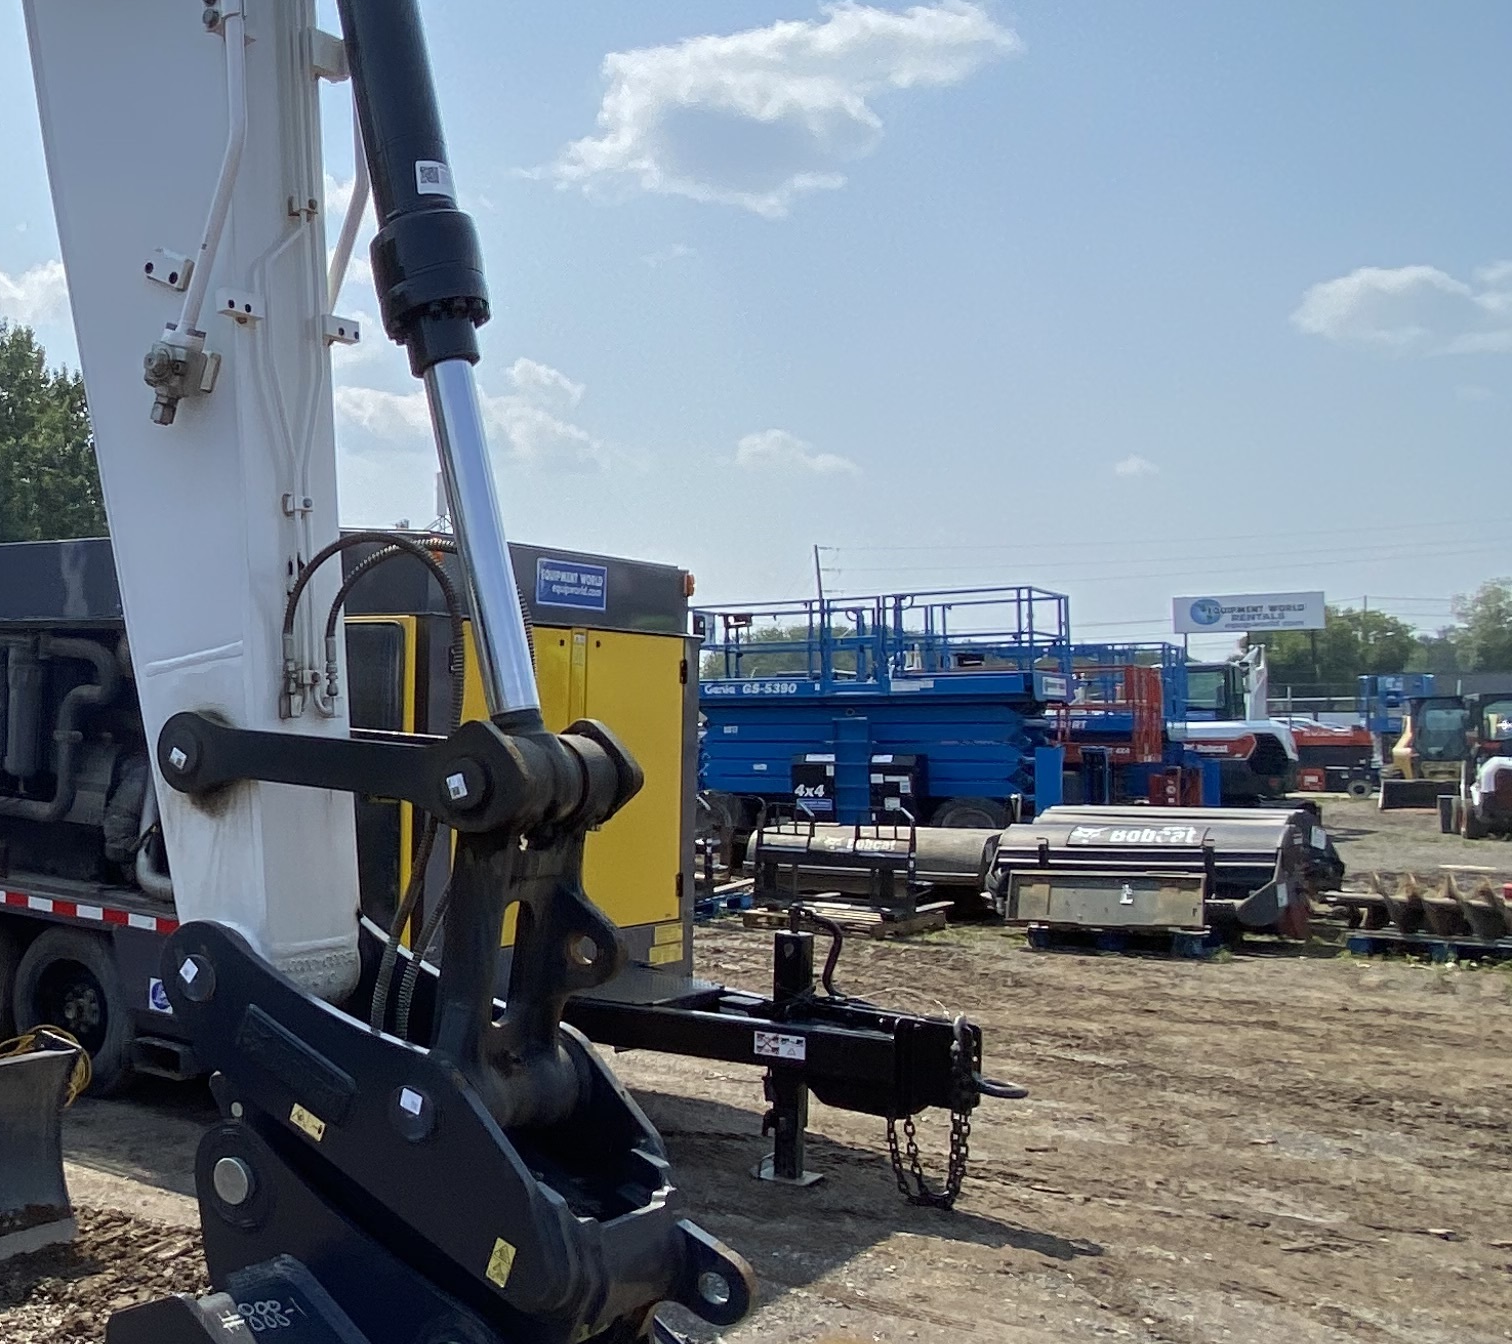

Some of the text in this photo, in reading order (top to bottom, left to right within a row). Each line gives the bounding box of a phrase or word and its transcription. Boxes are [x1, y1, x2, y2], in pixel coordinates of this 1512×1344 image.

[1268, 603, 1305, 612] WORLD
[1231, 612, 1286, 622] RENTALS
[704, 682, 798, 695] Genie GS-5390
[794, 783, 826, 798] 4x4
[1108, 825, 1197, 844] Bobcat
[846, 837, 897, 852] Bobcat
